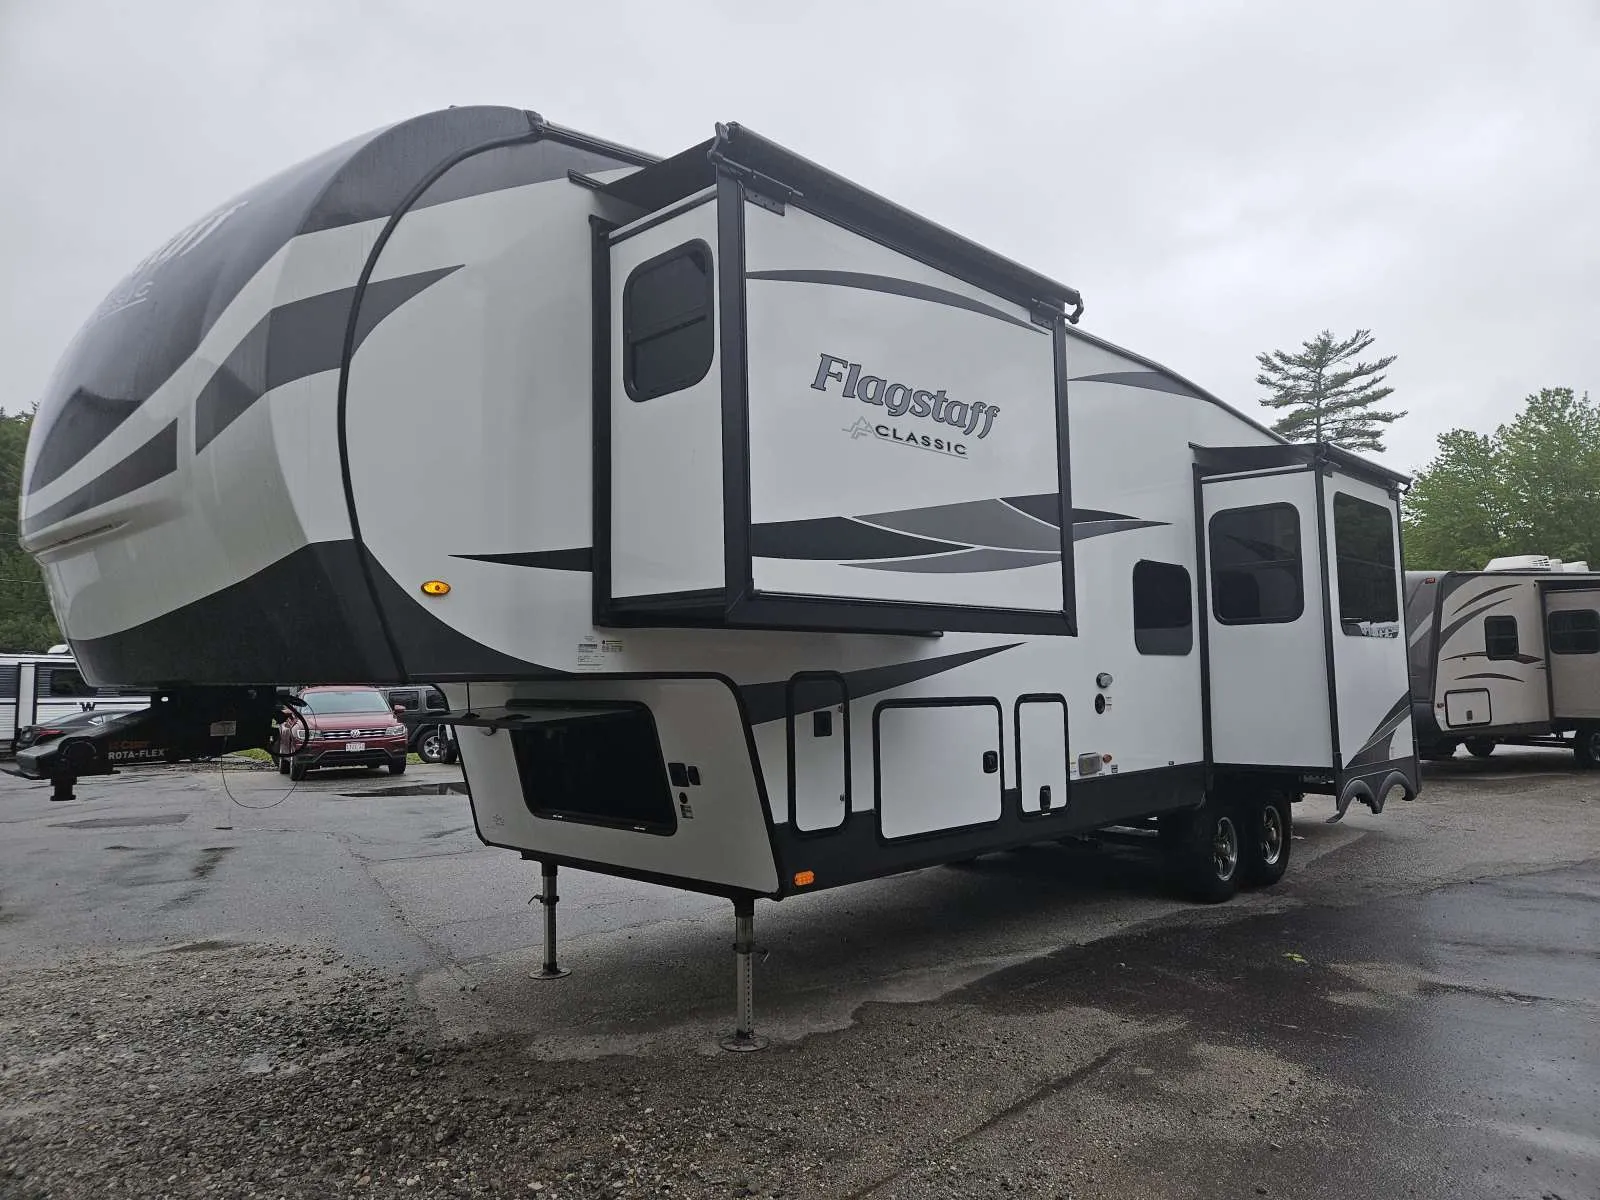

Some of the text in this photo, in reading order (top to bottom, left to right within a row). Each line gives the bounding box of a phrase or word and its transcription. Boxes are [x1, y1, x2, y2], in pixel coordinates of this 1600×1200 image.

[810, 352, 1000, 439] Flagstaff
[874, 424, 968, 455] CLASSIC
[107, 748, 166, 760] ROTA-FLEX
